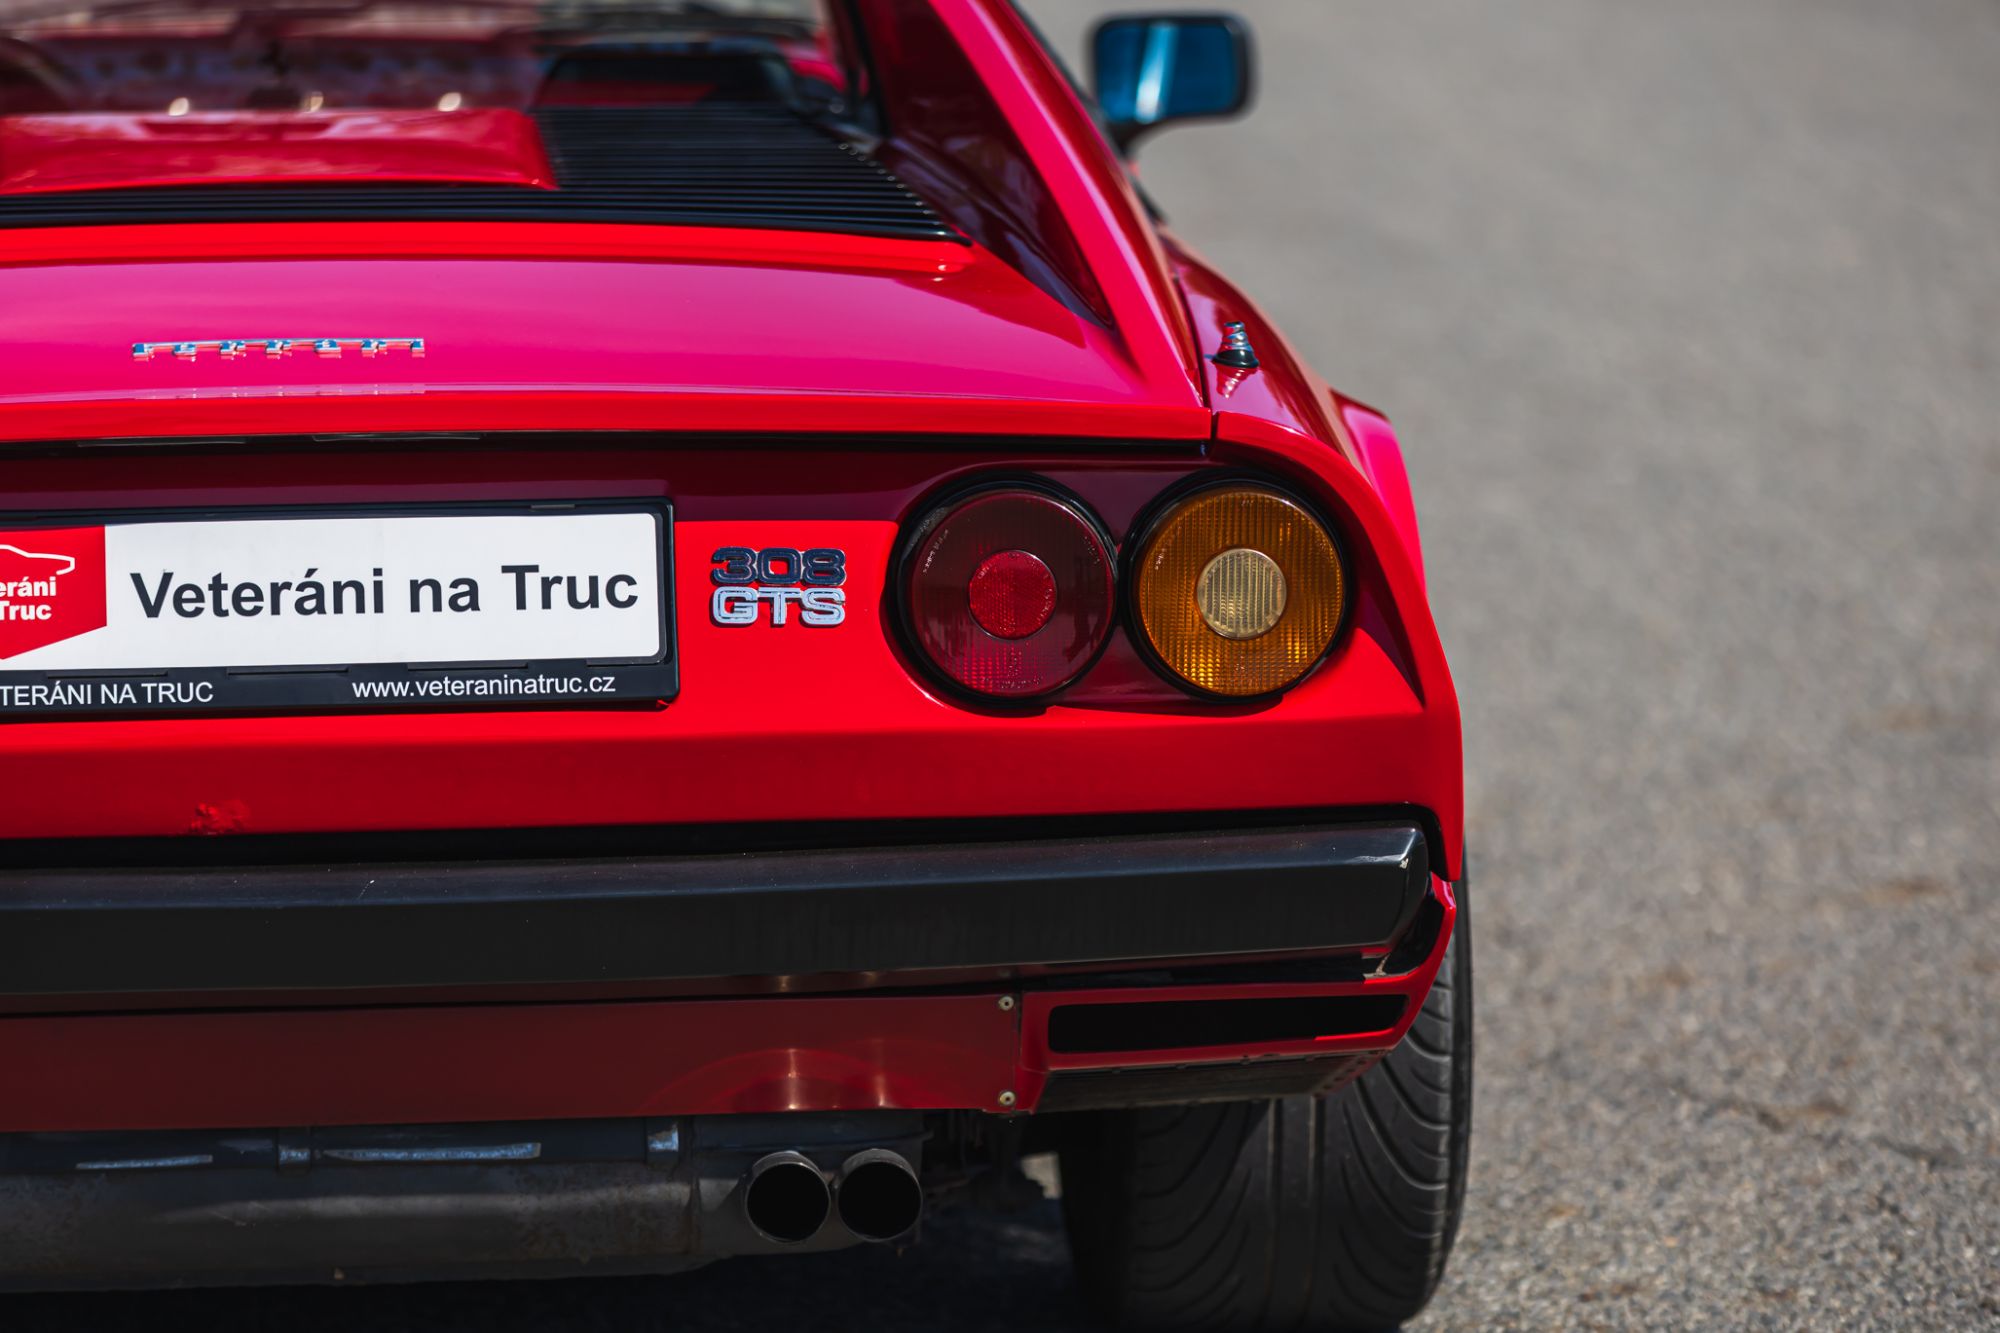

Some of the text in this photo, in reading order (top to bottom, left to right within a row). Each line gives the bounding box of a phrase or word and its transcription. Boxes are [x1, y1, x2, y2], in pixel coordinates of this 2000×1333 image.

[711, 546, 846, 585] 308
[130, 564, 639, 619] Veteráni na Truc
[711, 586, 846, 626] GTS
[0, 680, 214, 706] TERÁNI NA TRUC
[352, 674, 616, 698] www.veteraninatruc.cz
